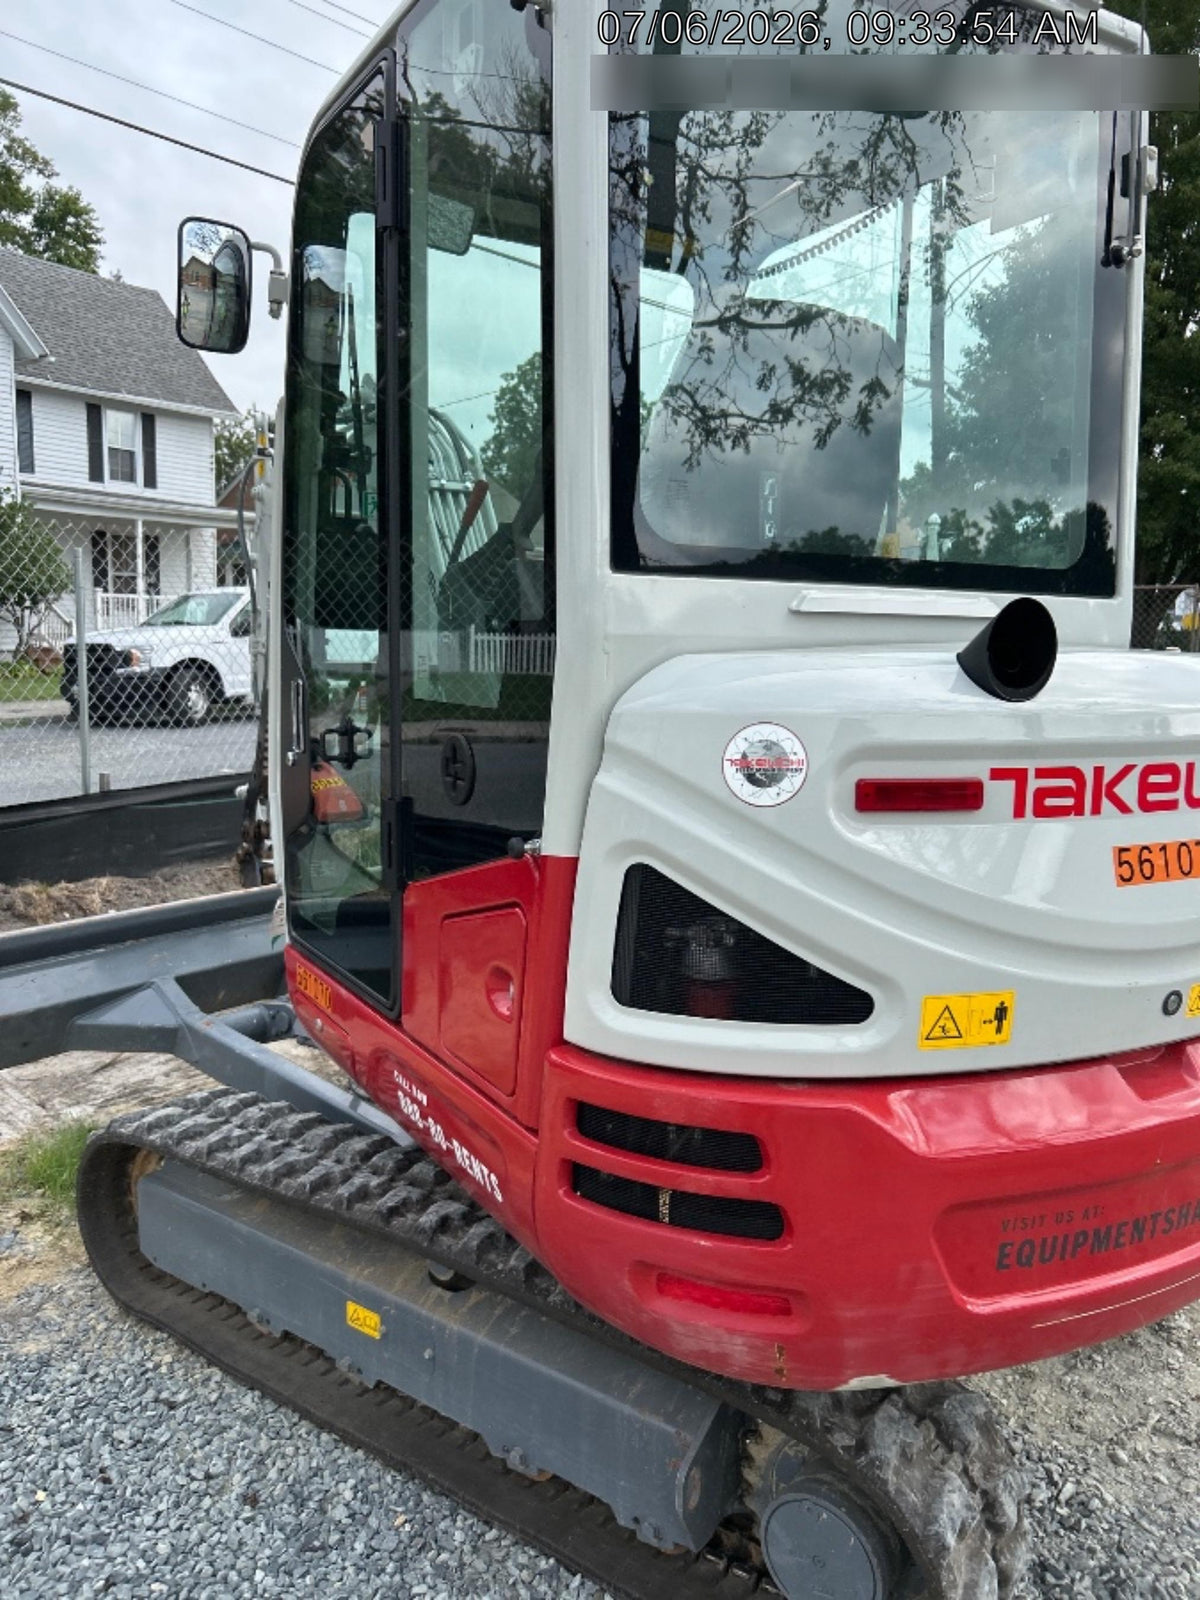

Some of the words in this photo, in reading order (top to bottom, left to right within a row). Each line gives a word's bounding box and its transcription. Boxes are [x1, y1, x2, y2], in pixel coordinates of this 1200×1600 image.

[1117, 840, 1200, 883] 5610
[1002, 1215, 1047, 1233] VISIT
[1055, 1210, 1075, 1225] US
